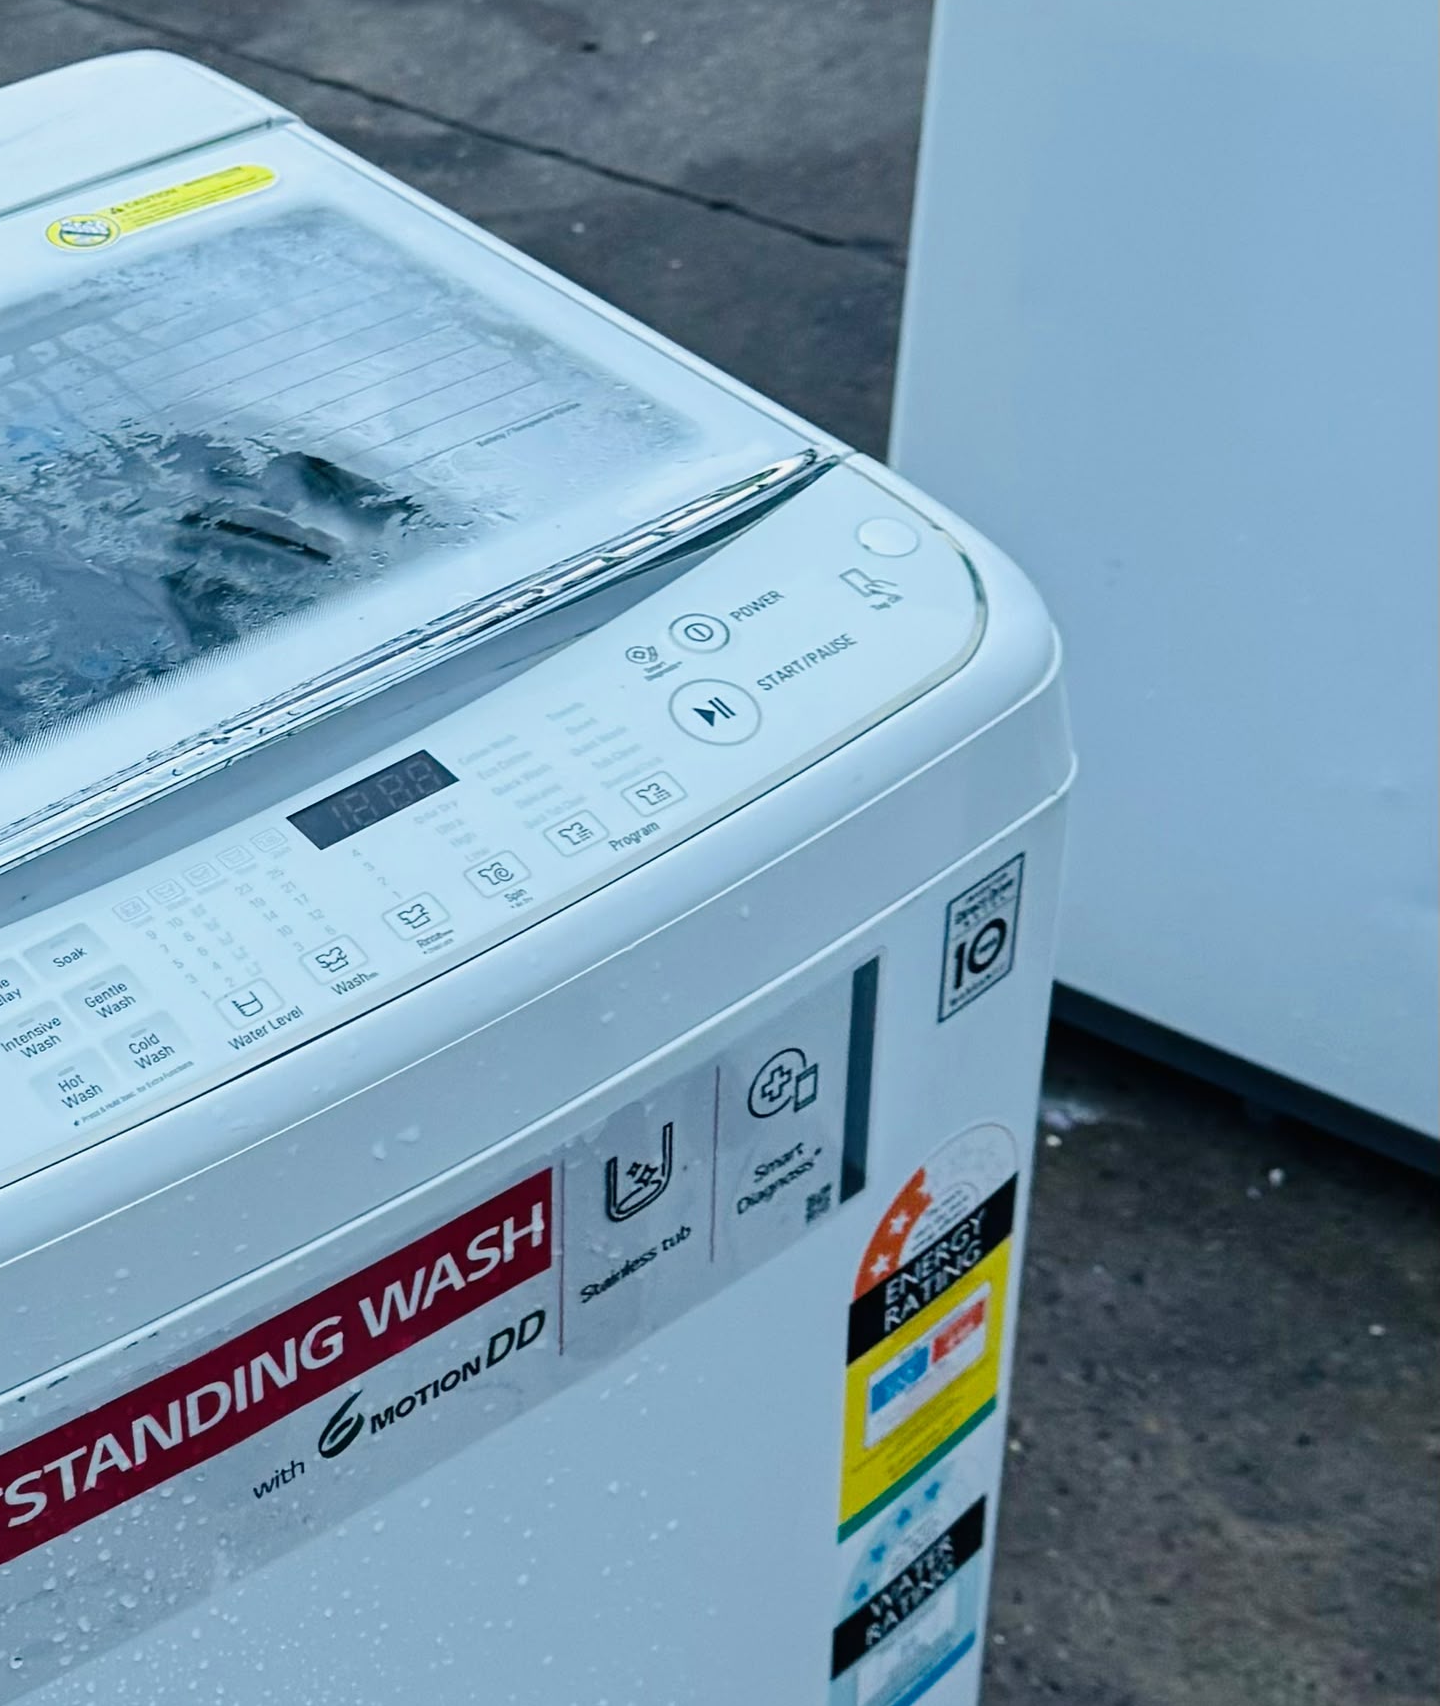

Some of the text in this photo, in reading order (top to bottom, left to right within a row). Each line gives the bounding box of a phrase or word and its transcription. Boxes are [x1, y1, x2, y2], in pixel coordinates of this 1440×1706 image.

[729, 590, 785, 623] POWER
[757, 633, 858, 691] START/PAUSE
[608, 821, 660, 853] Program
[53, 947, 87, 968] Soak
[84, 981, 127, 1009] Gentle
[331, 972, 368, 996] Wash
[96, 994, 136, 1019] Wash
[0, 1016, 61, 1052] Intensive
[128, 1033, 160, 1055] Cold
[228, 1005, 304, 1051] Water Level
[20, 1033, 62, 1059] Wash
[134, 1044, 175, 1069] Wash
[58, 1073, 84, 1093] Hot
[61, 1082, 102, 1109] Wash
[754, 1142, 804, 1183] Smart
[358, 1202, 545, 1338] WASH
[580, 1226, 691, 1304] Stainless tub
[885, 1207, 987, 1306] ENERGY
[884, 1241, 983, 1333] RATING
[253, 1460, 305, 1499] with
